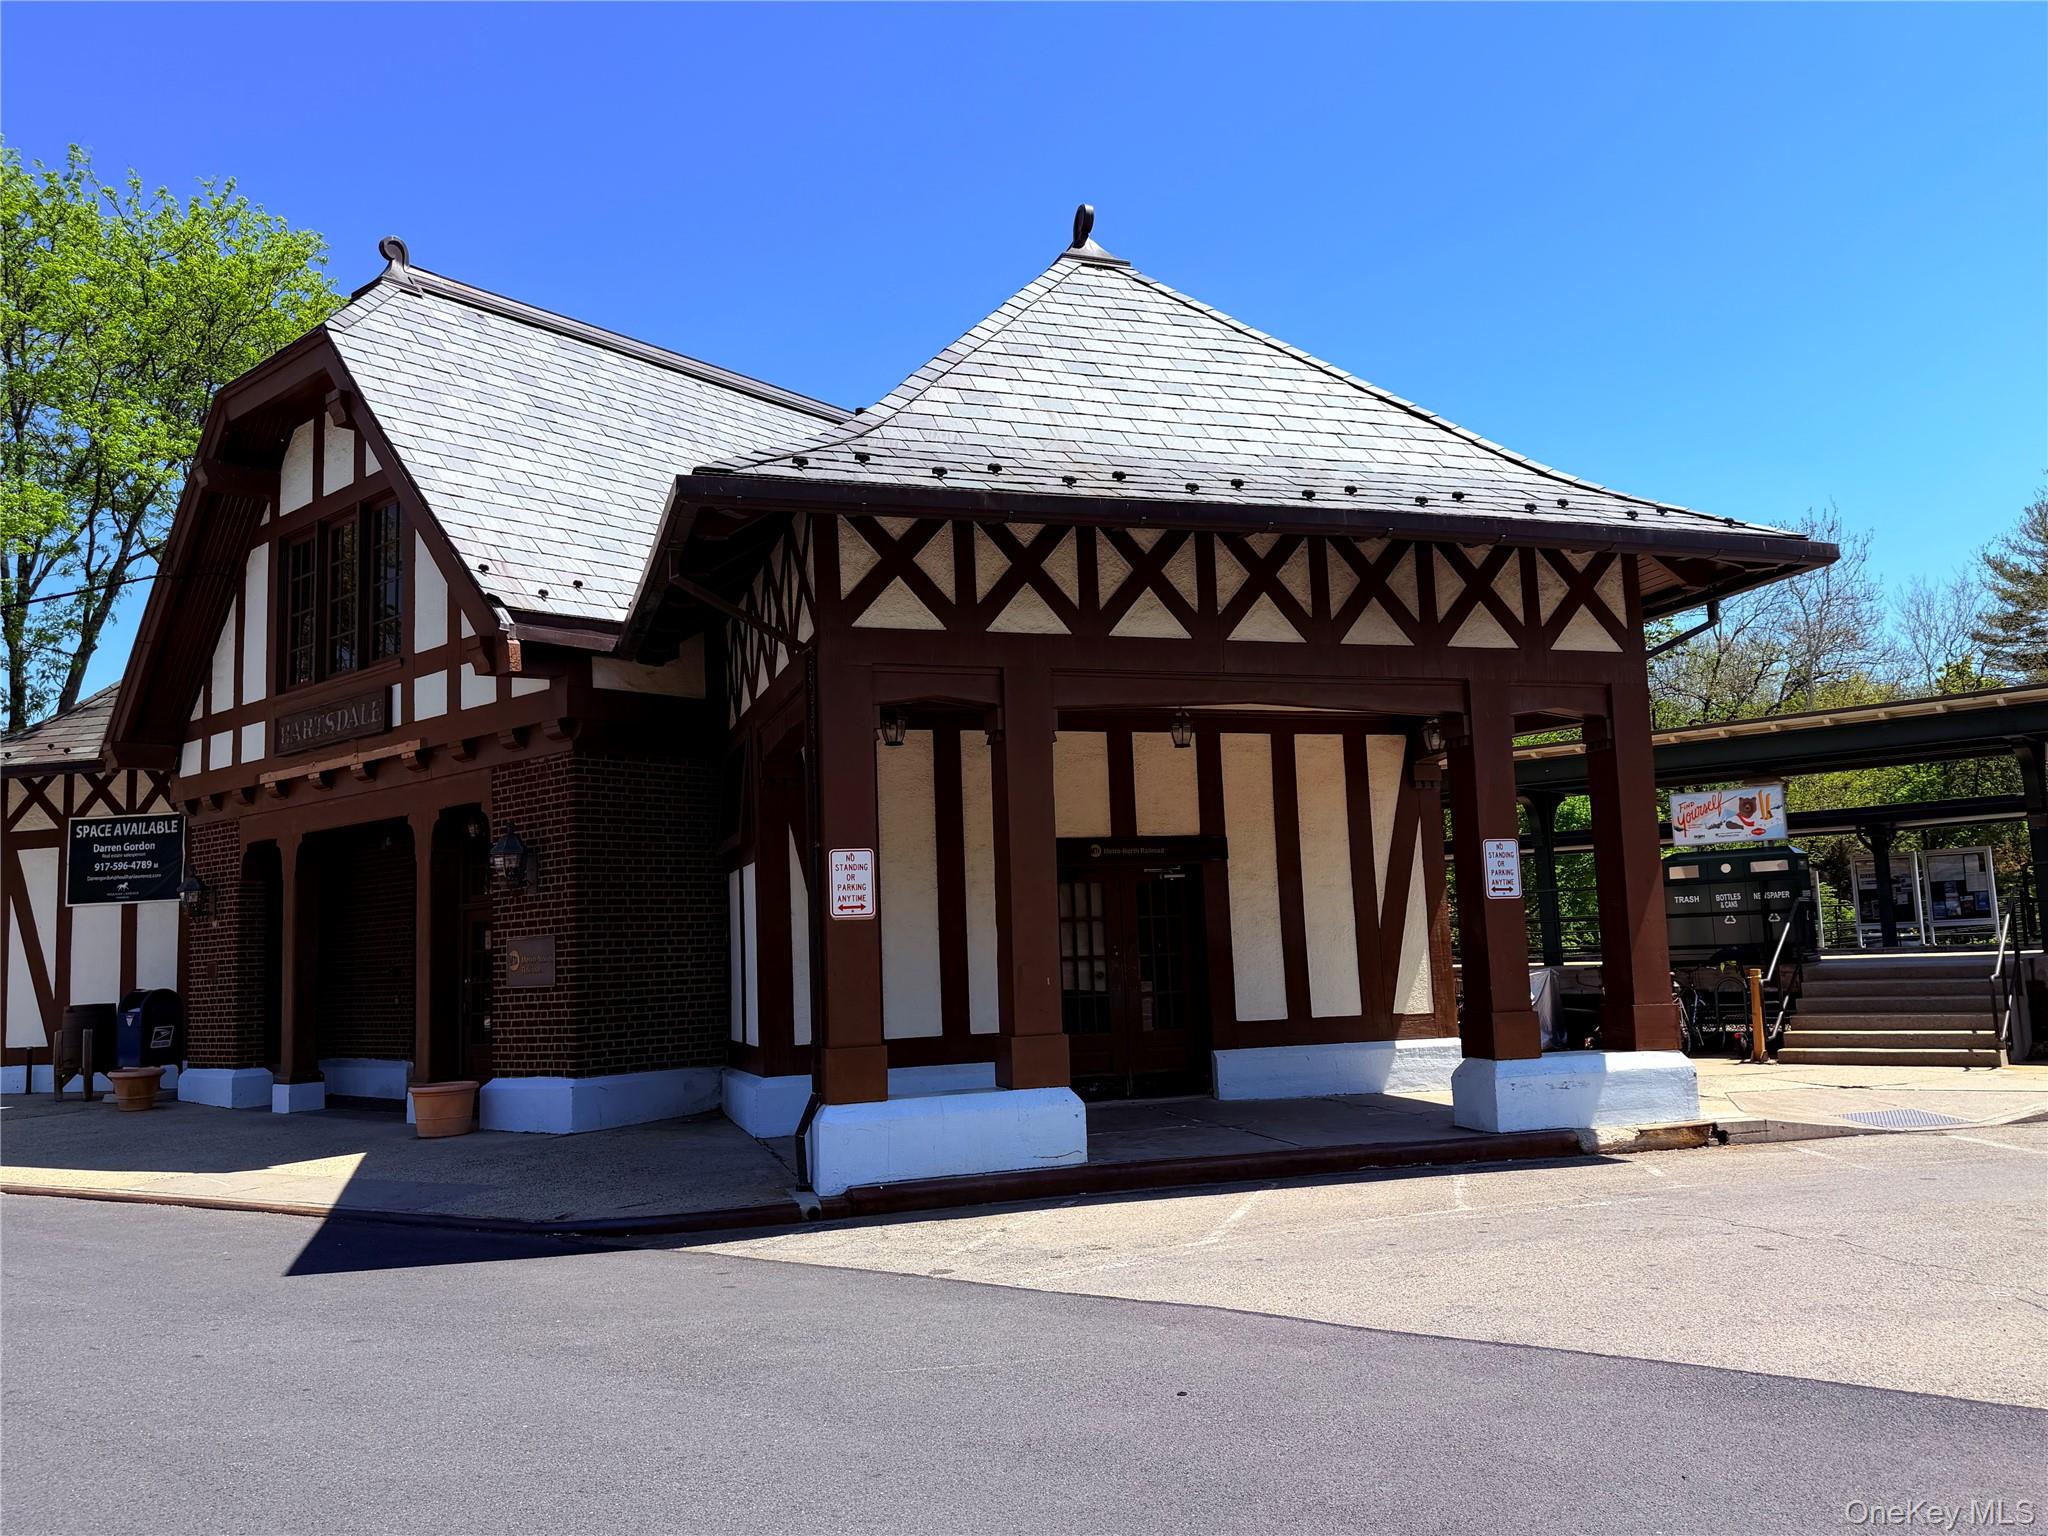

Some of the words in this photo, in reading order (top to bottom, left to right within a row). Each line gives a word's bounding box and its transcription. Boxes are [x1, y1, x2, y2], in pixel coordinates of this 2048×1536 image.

[280, 699, 383, 745] HARTSDALE
[76, 823, 112, 839] SPACE
[113, 820, 179, 836] AVAILABLE
[93, 843, 122, 853] Darren
[123, 841, 156, 852] Gordon
[1495, 842, 1503, 850] NO
[845, 853, 855, 862] NO
[1488, 851, 1514, 859] STANDING
[94, 860, 153, 872] 917-596-4789
[835, 863, 868, 872] STANDING
[837, 883, 867, 892] PARKING
[837, 894, 867, 902] ANYTIME
[1674, 895, 1700, 904] TRASH
[1715, 892, 1742, 902] BOTTLES
[1724, 900, 1738, 909] CANS
